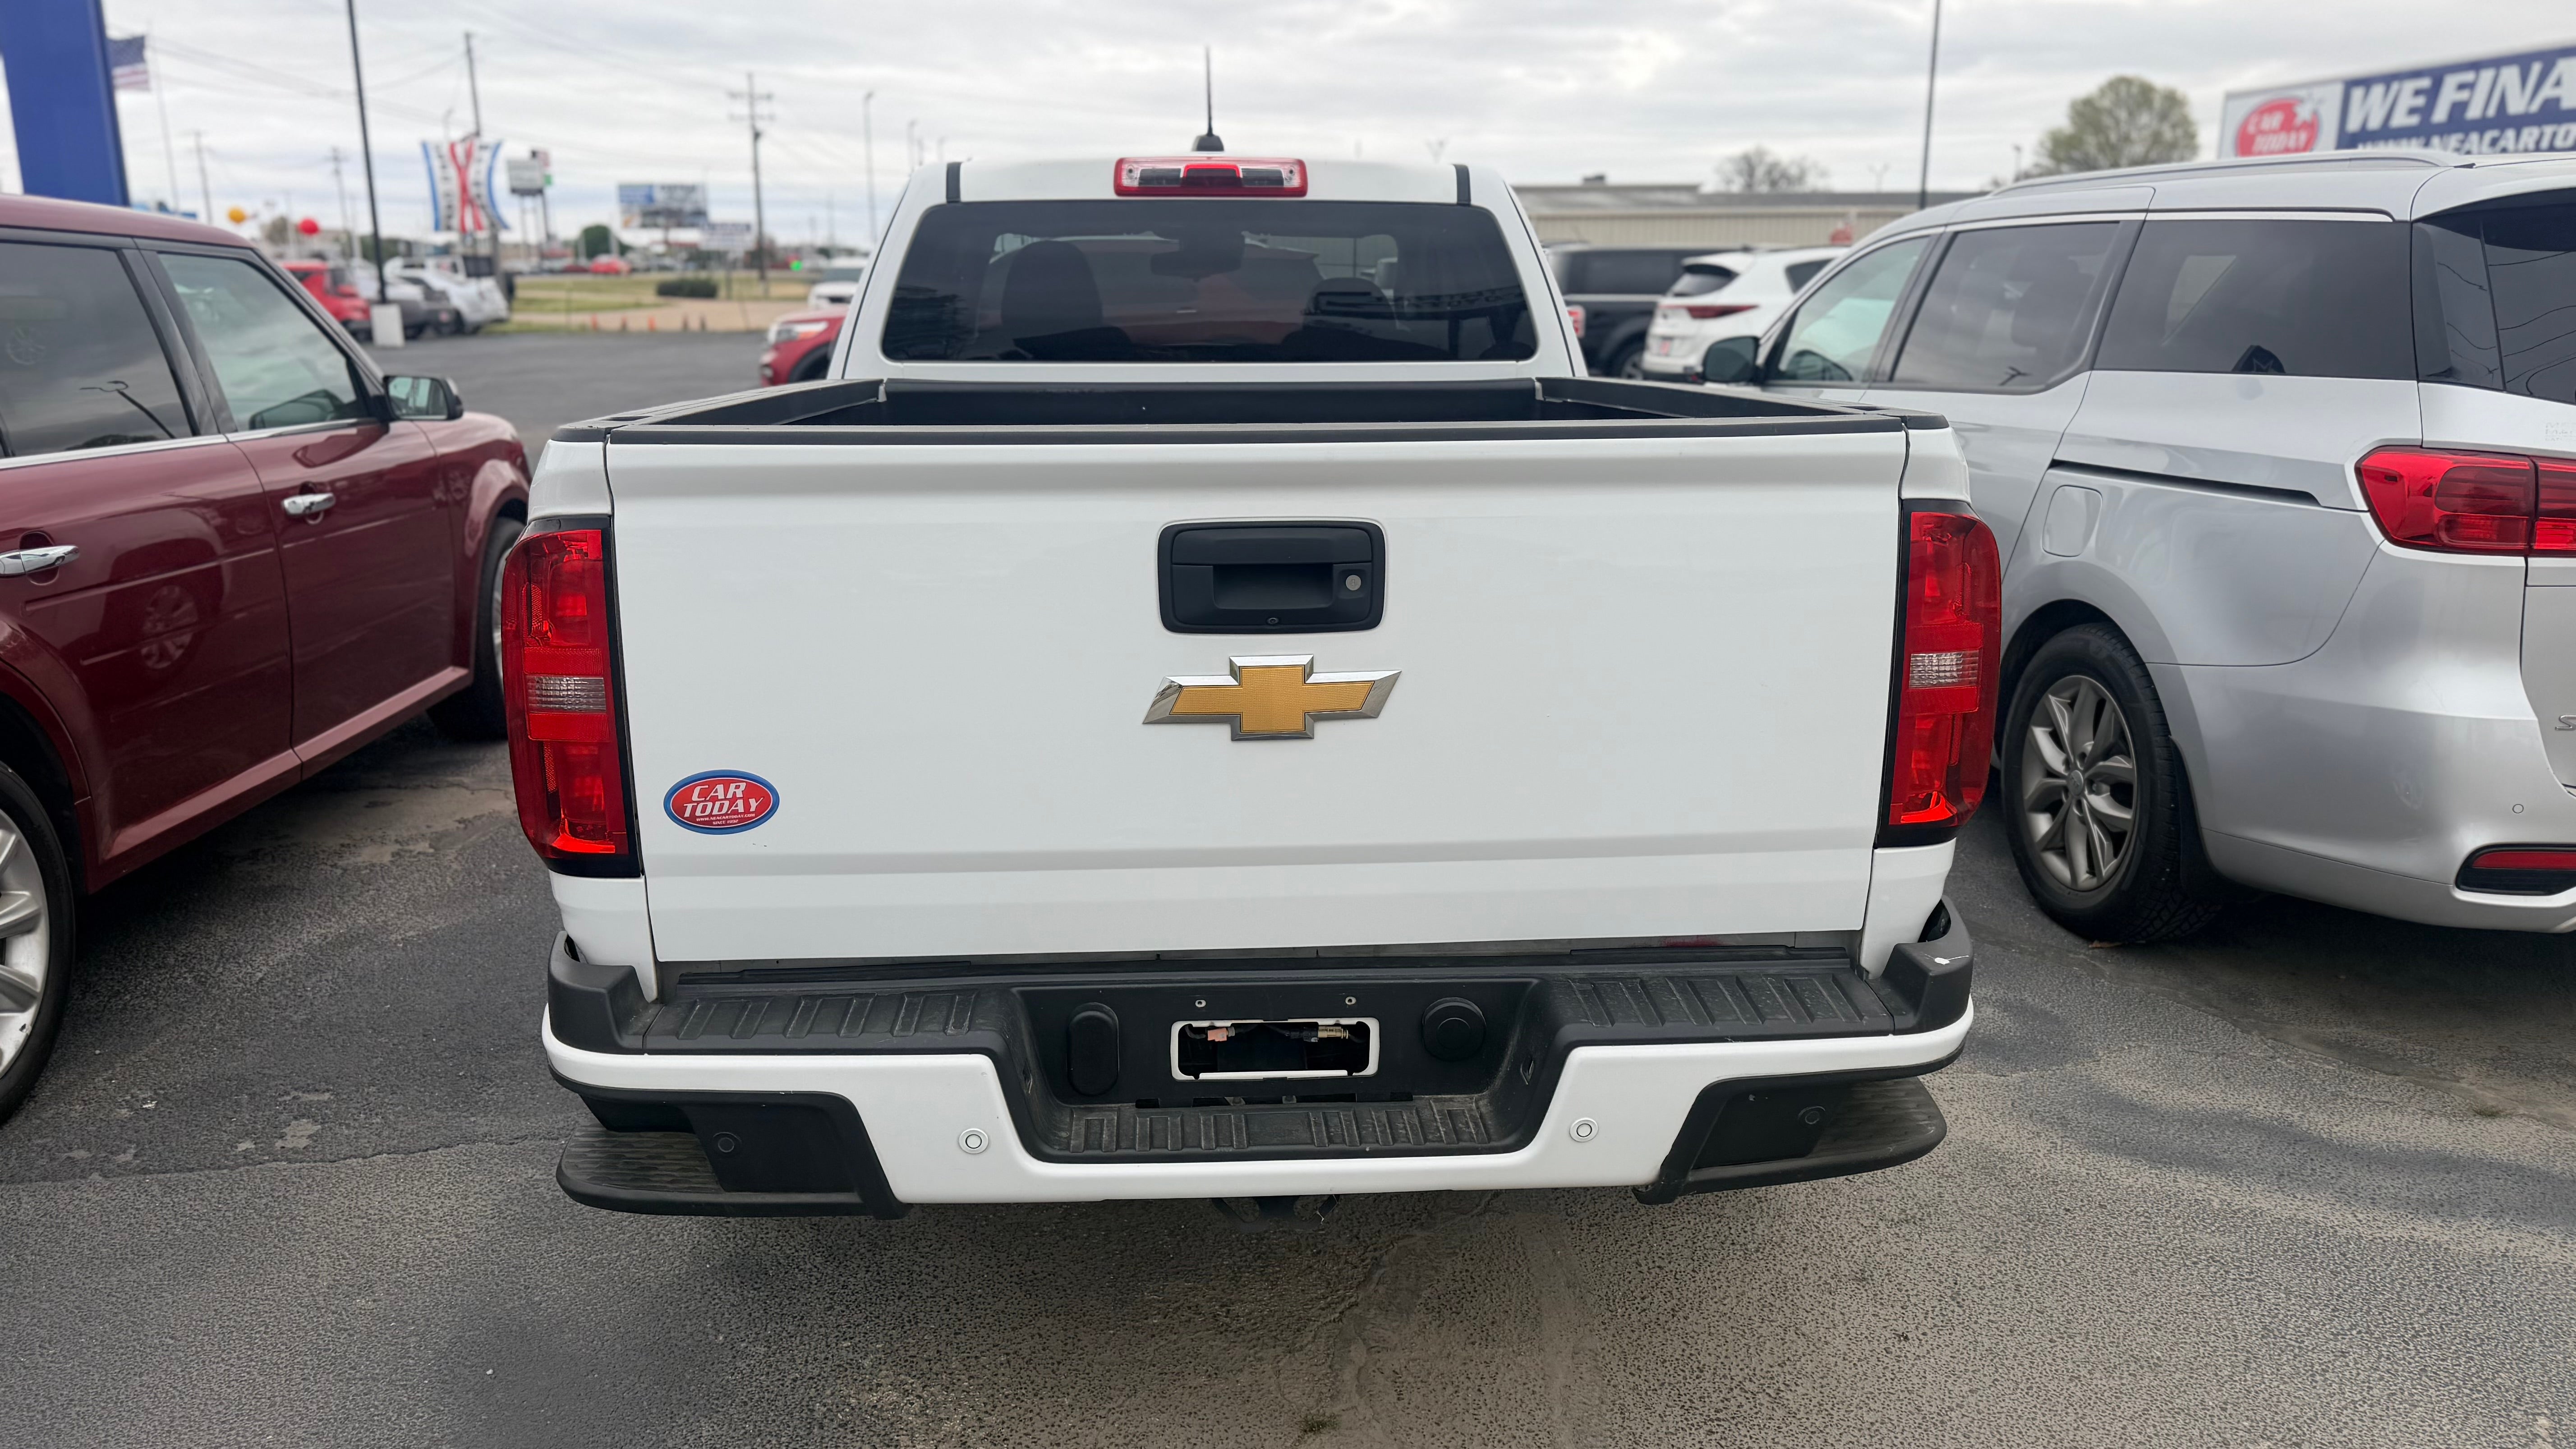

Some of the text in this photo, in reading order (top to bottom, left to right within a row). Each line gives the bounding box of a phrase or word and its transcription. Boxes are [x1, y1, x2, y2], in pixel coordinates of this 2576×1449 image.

[2346, 56, 2576, 133] WE FINA
[692, 782, 746, 801] CAR
[683, 797, 764, 818] TODAY
